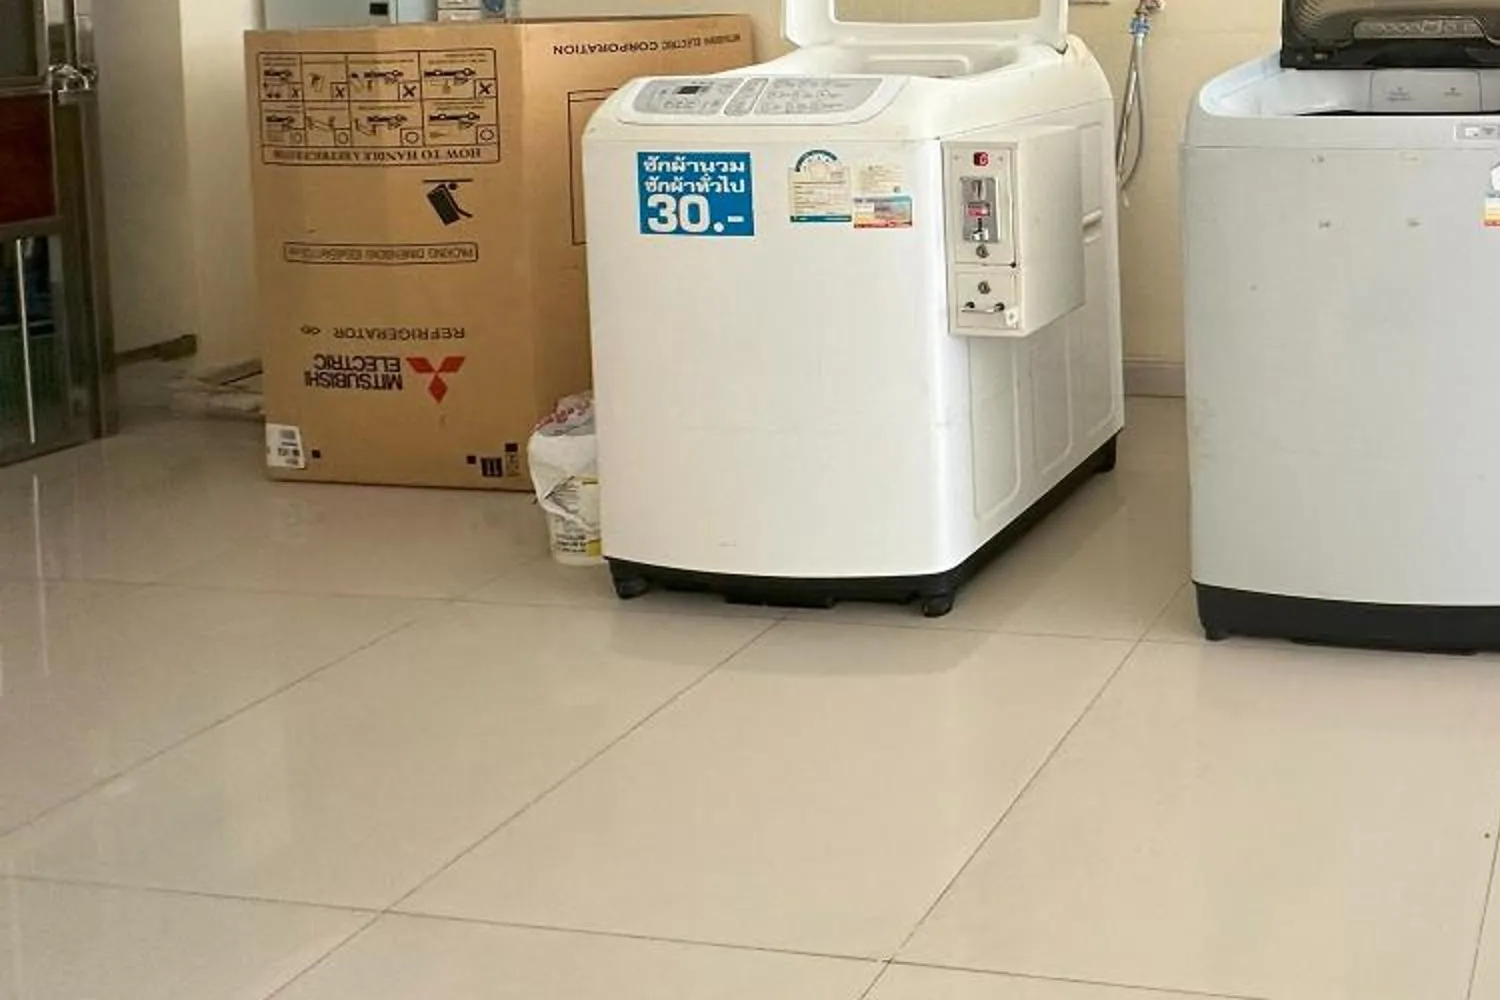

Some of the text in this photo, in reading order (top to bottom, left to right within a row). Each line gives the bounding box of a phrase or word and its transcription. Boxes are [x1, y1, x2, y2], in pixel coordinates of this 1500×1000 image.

[552, 41, 659, 56] CORPORATION
[421, 149, 440, 160] TO
[448, 147, 481, 159] HOW
[333, 326, 465, 341] REFRIGERATOR
[313, 353, 401, 373] ELECTRIC
[303, 370, 403, 391] MITSUBISHI
